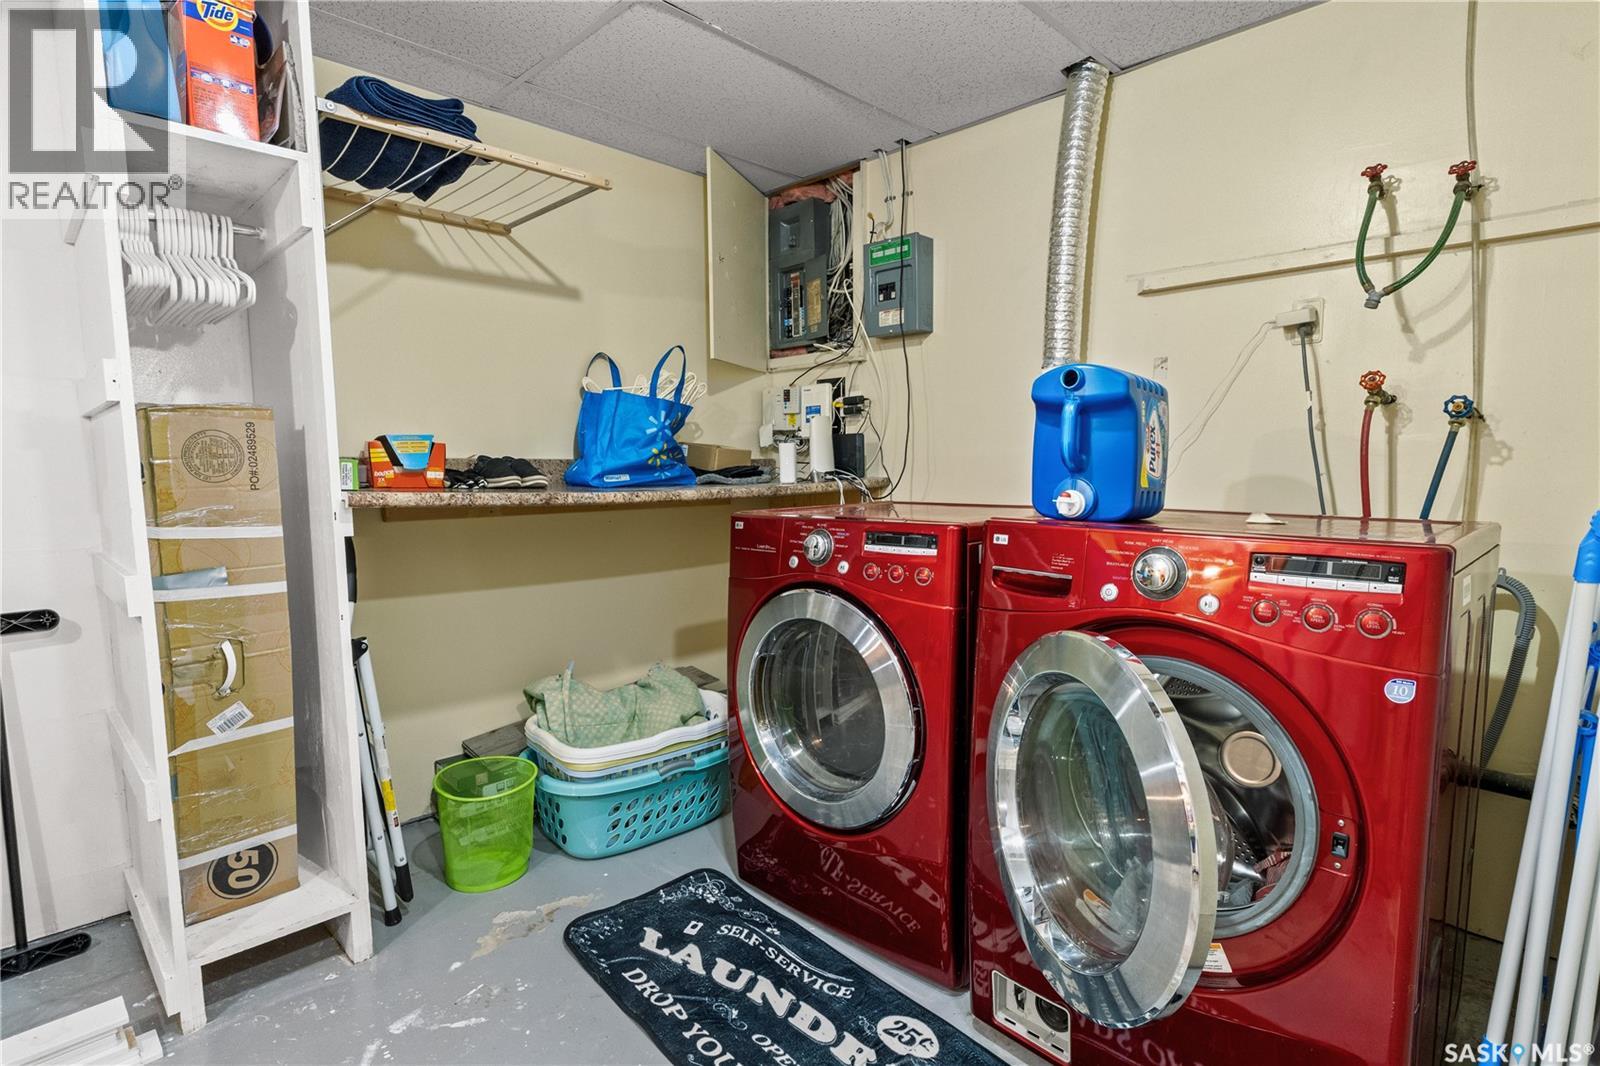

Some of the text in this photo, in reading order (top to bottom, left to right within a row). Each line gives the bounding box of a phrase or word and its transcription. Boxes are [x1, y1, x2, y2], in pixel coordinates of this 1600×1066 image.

[201, 0, 234, 21] Tide
[1393, 685, 1409, 697] 10
[716, 924, 855, 999] SELF-SERVICE
[622, 967, 688, 1021] DROP
[639, 927, 896, 1066] LAUNDR
